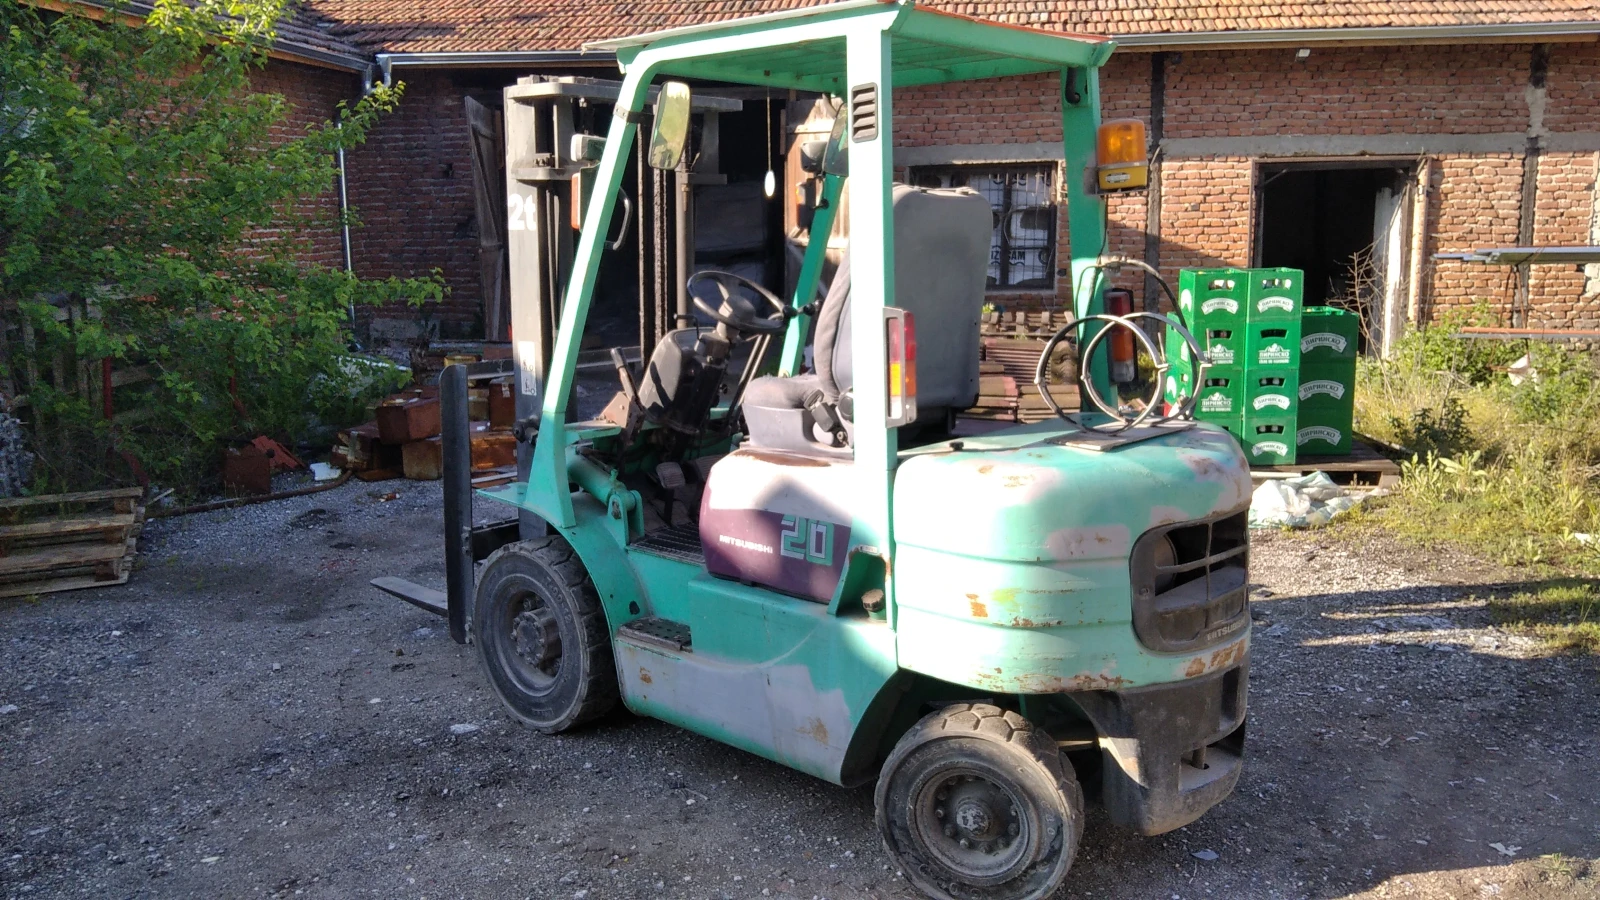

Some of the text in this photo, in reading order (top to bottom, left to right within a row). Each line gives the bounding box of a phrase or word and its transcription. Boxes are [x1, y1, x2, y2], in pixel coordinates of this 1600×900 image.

[508, 193, 536, 231] 2t
[1304, 336, 1341, 346] ПИРИНСКО
[1303, 383, 1339, 394] ПИРИНСКО
[1300, 429, 1336, 439] ПИРИНСКО
[719, 534, 773, 554] MITSUBISHI
[780, 513, 834, 566] 20
[1206, 619, 1245, 641] MITSUB
